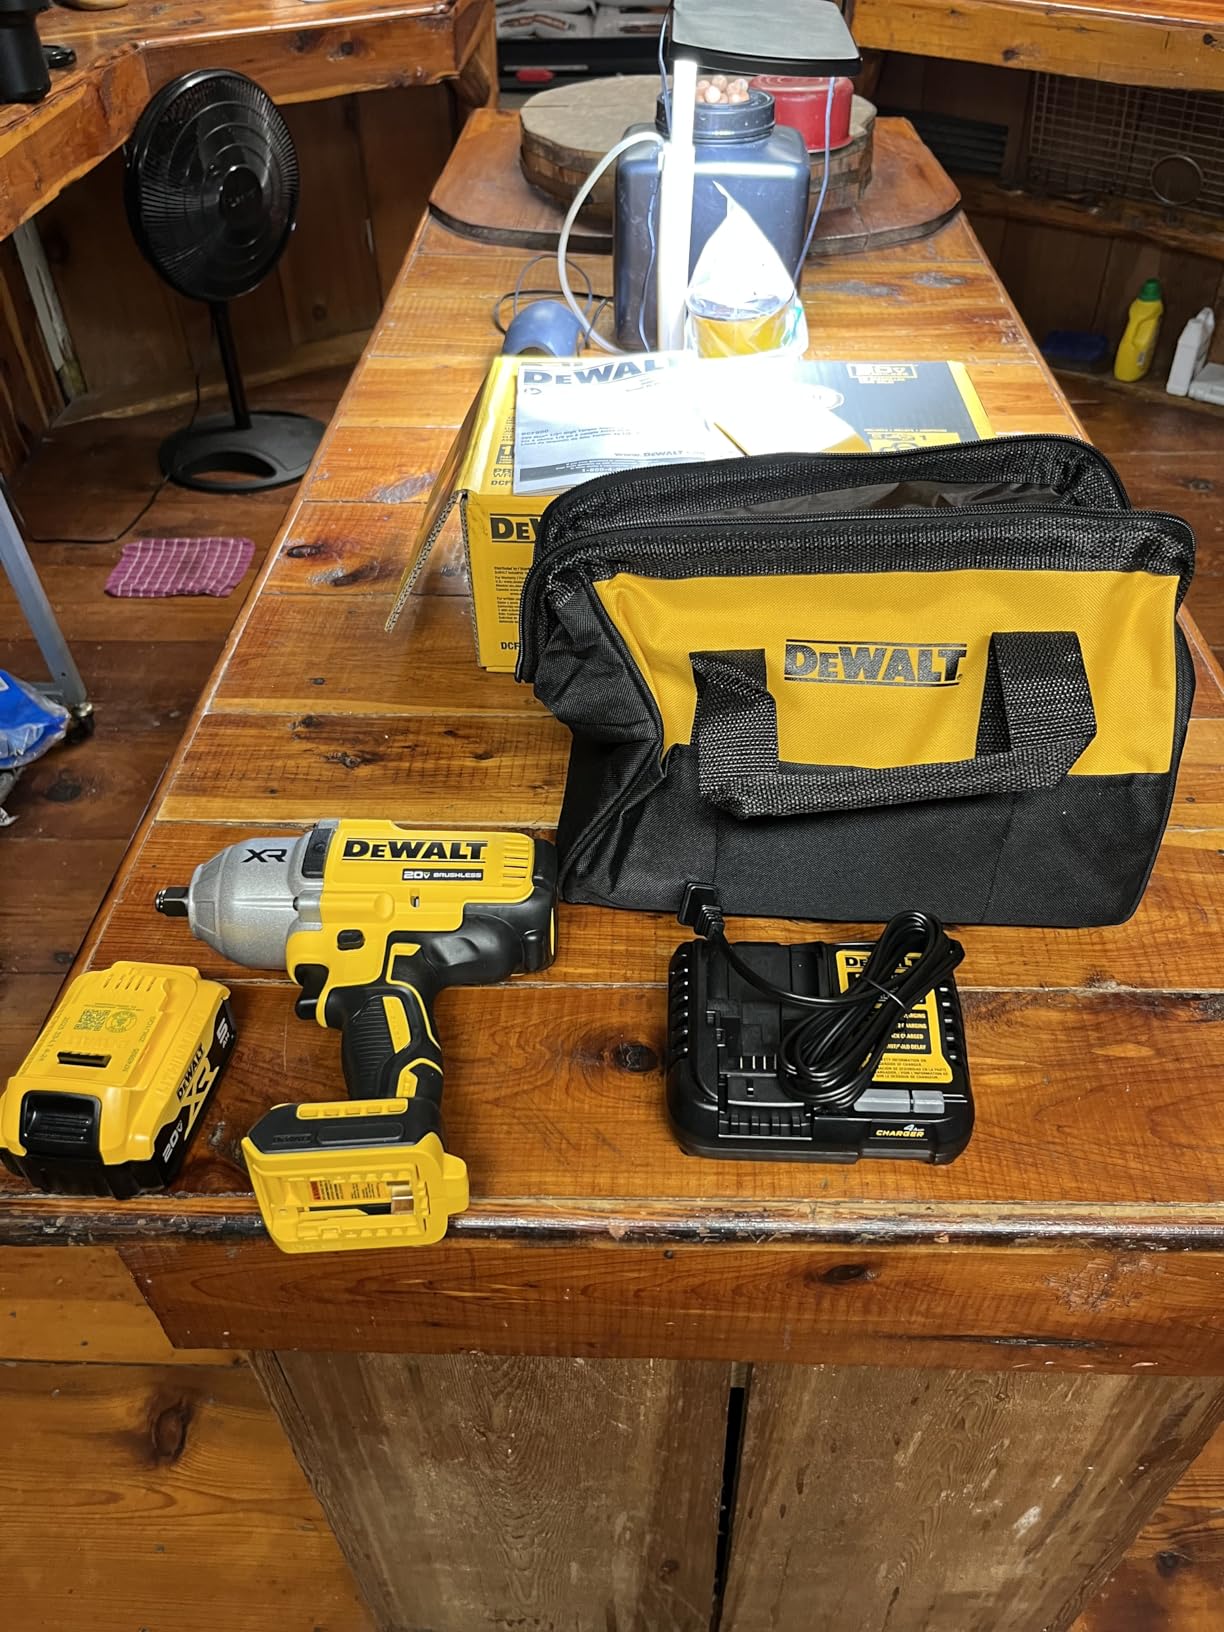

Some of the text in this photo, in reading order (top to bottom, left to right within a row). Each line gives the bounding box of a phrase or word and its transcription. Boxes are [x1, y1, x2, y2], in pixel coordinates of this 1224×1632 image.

[784, 643, 967, 682] DEWALT
[241, 849, 288, 863] XR
[343, 840, 488, 860] DEWALT
[876, 1130, 925, 1138] CHARGER
